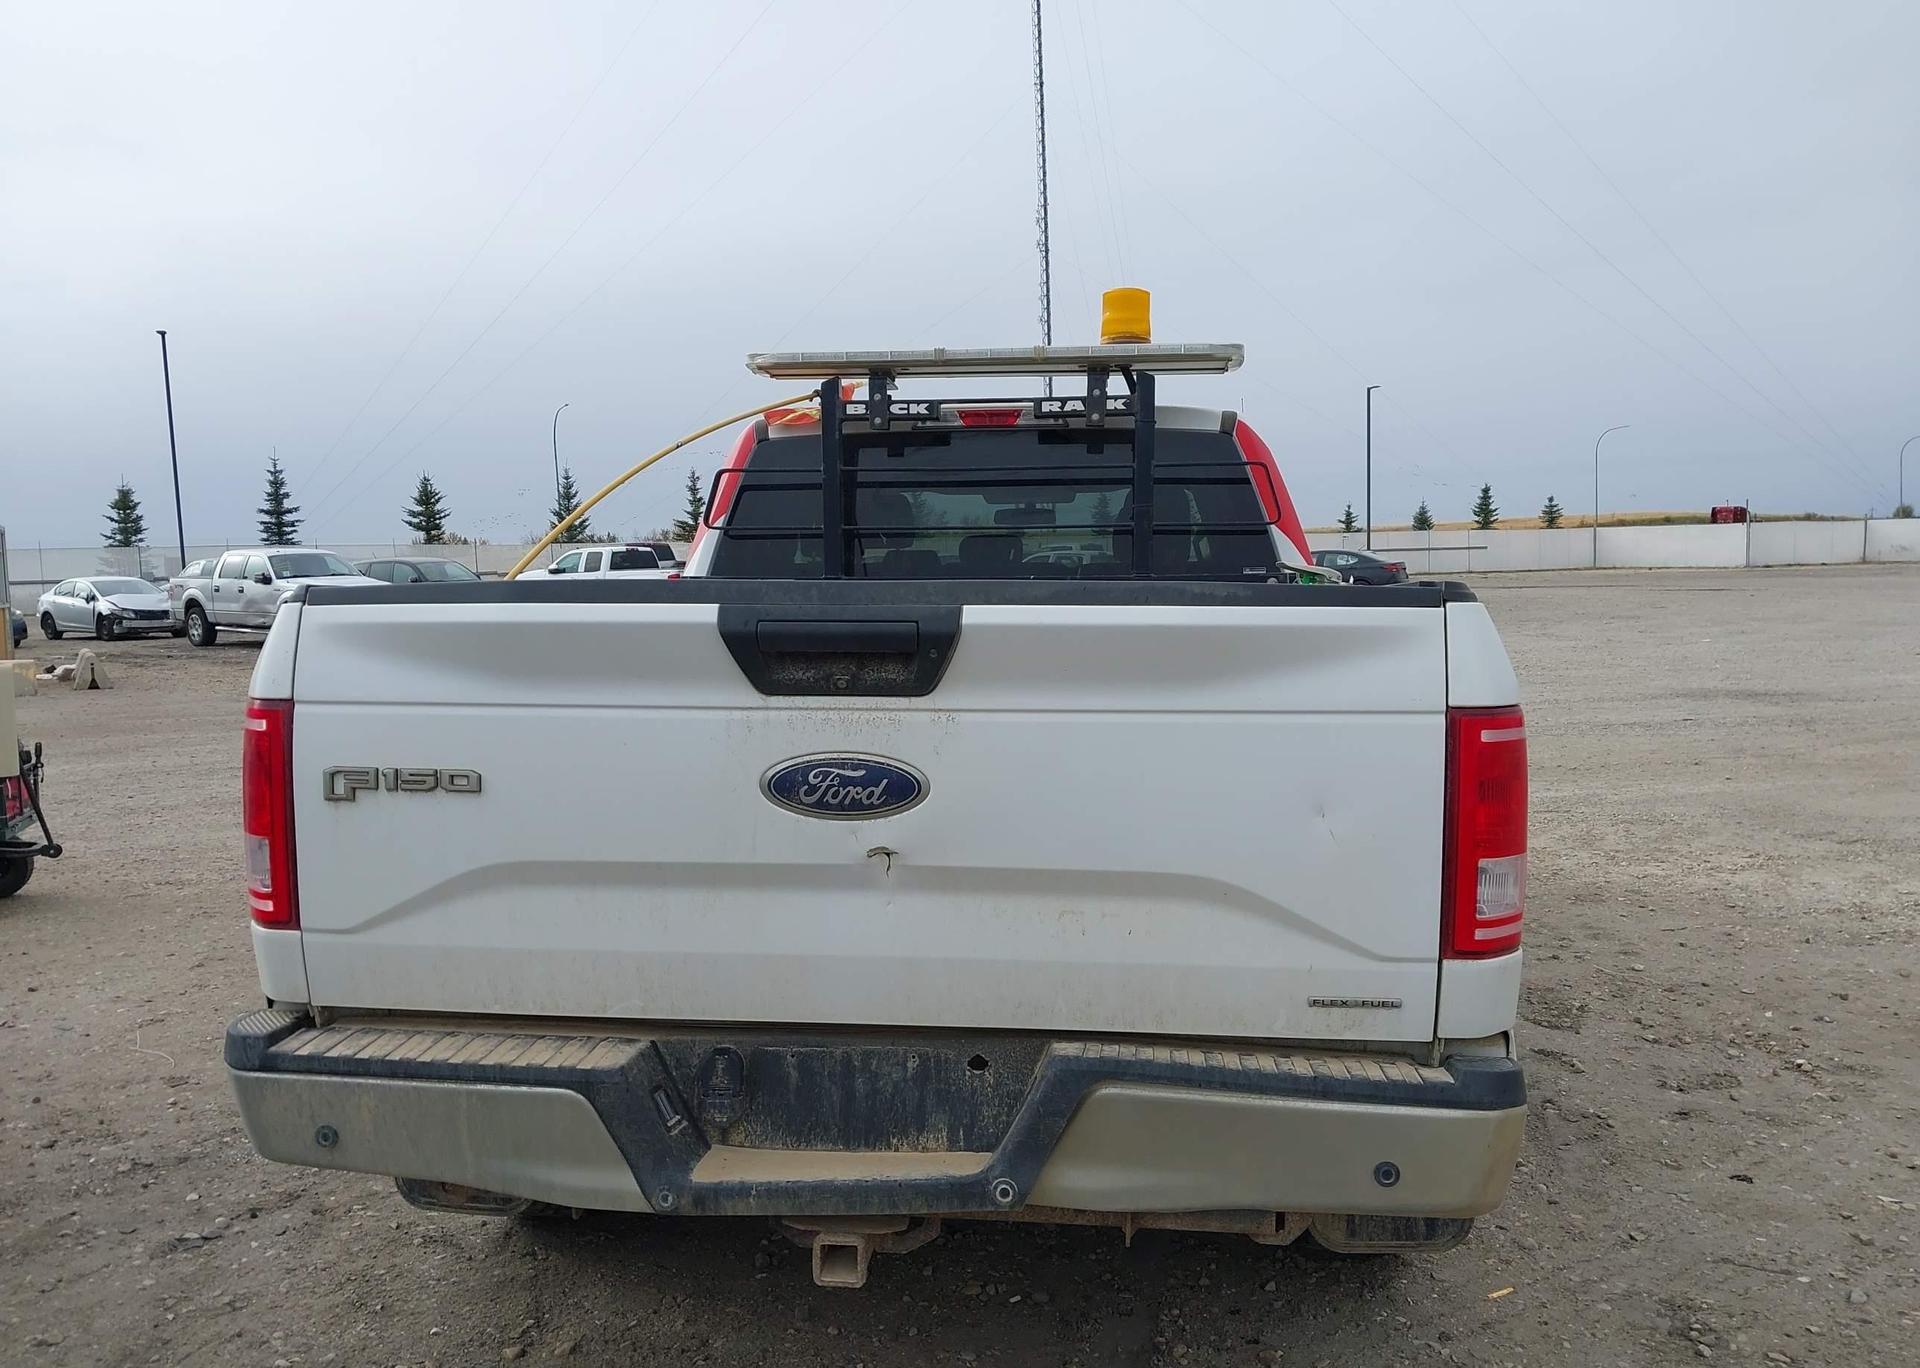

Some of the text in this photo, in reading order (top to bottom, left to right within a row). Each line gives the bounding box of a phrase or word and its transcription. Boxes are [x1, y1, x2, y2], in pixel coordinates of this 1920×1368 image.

[846, 398, 1128, 415] BCK RAK
[800, 767, 889, 805] Ford
[1312, 999, 1400, 1009] FLEX FUEL
